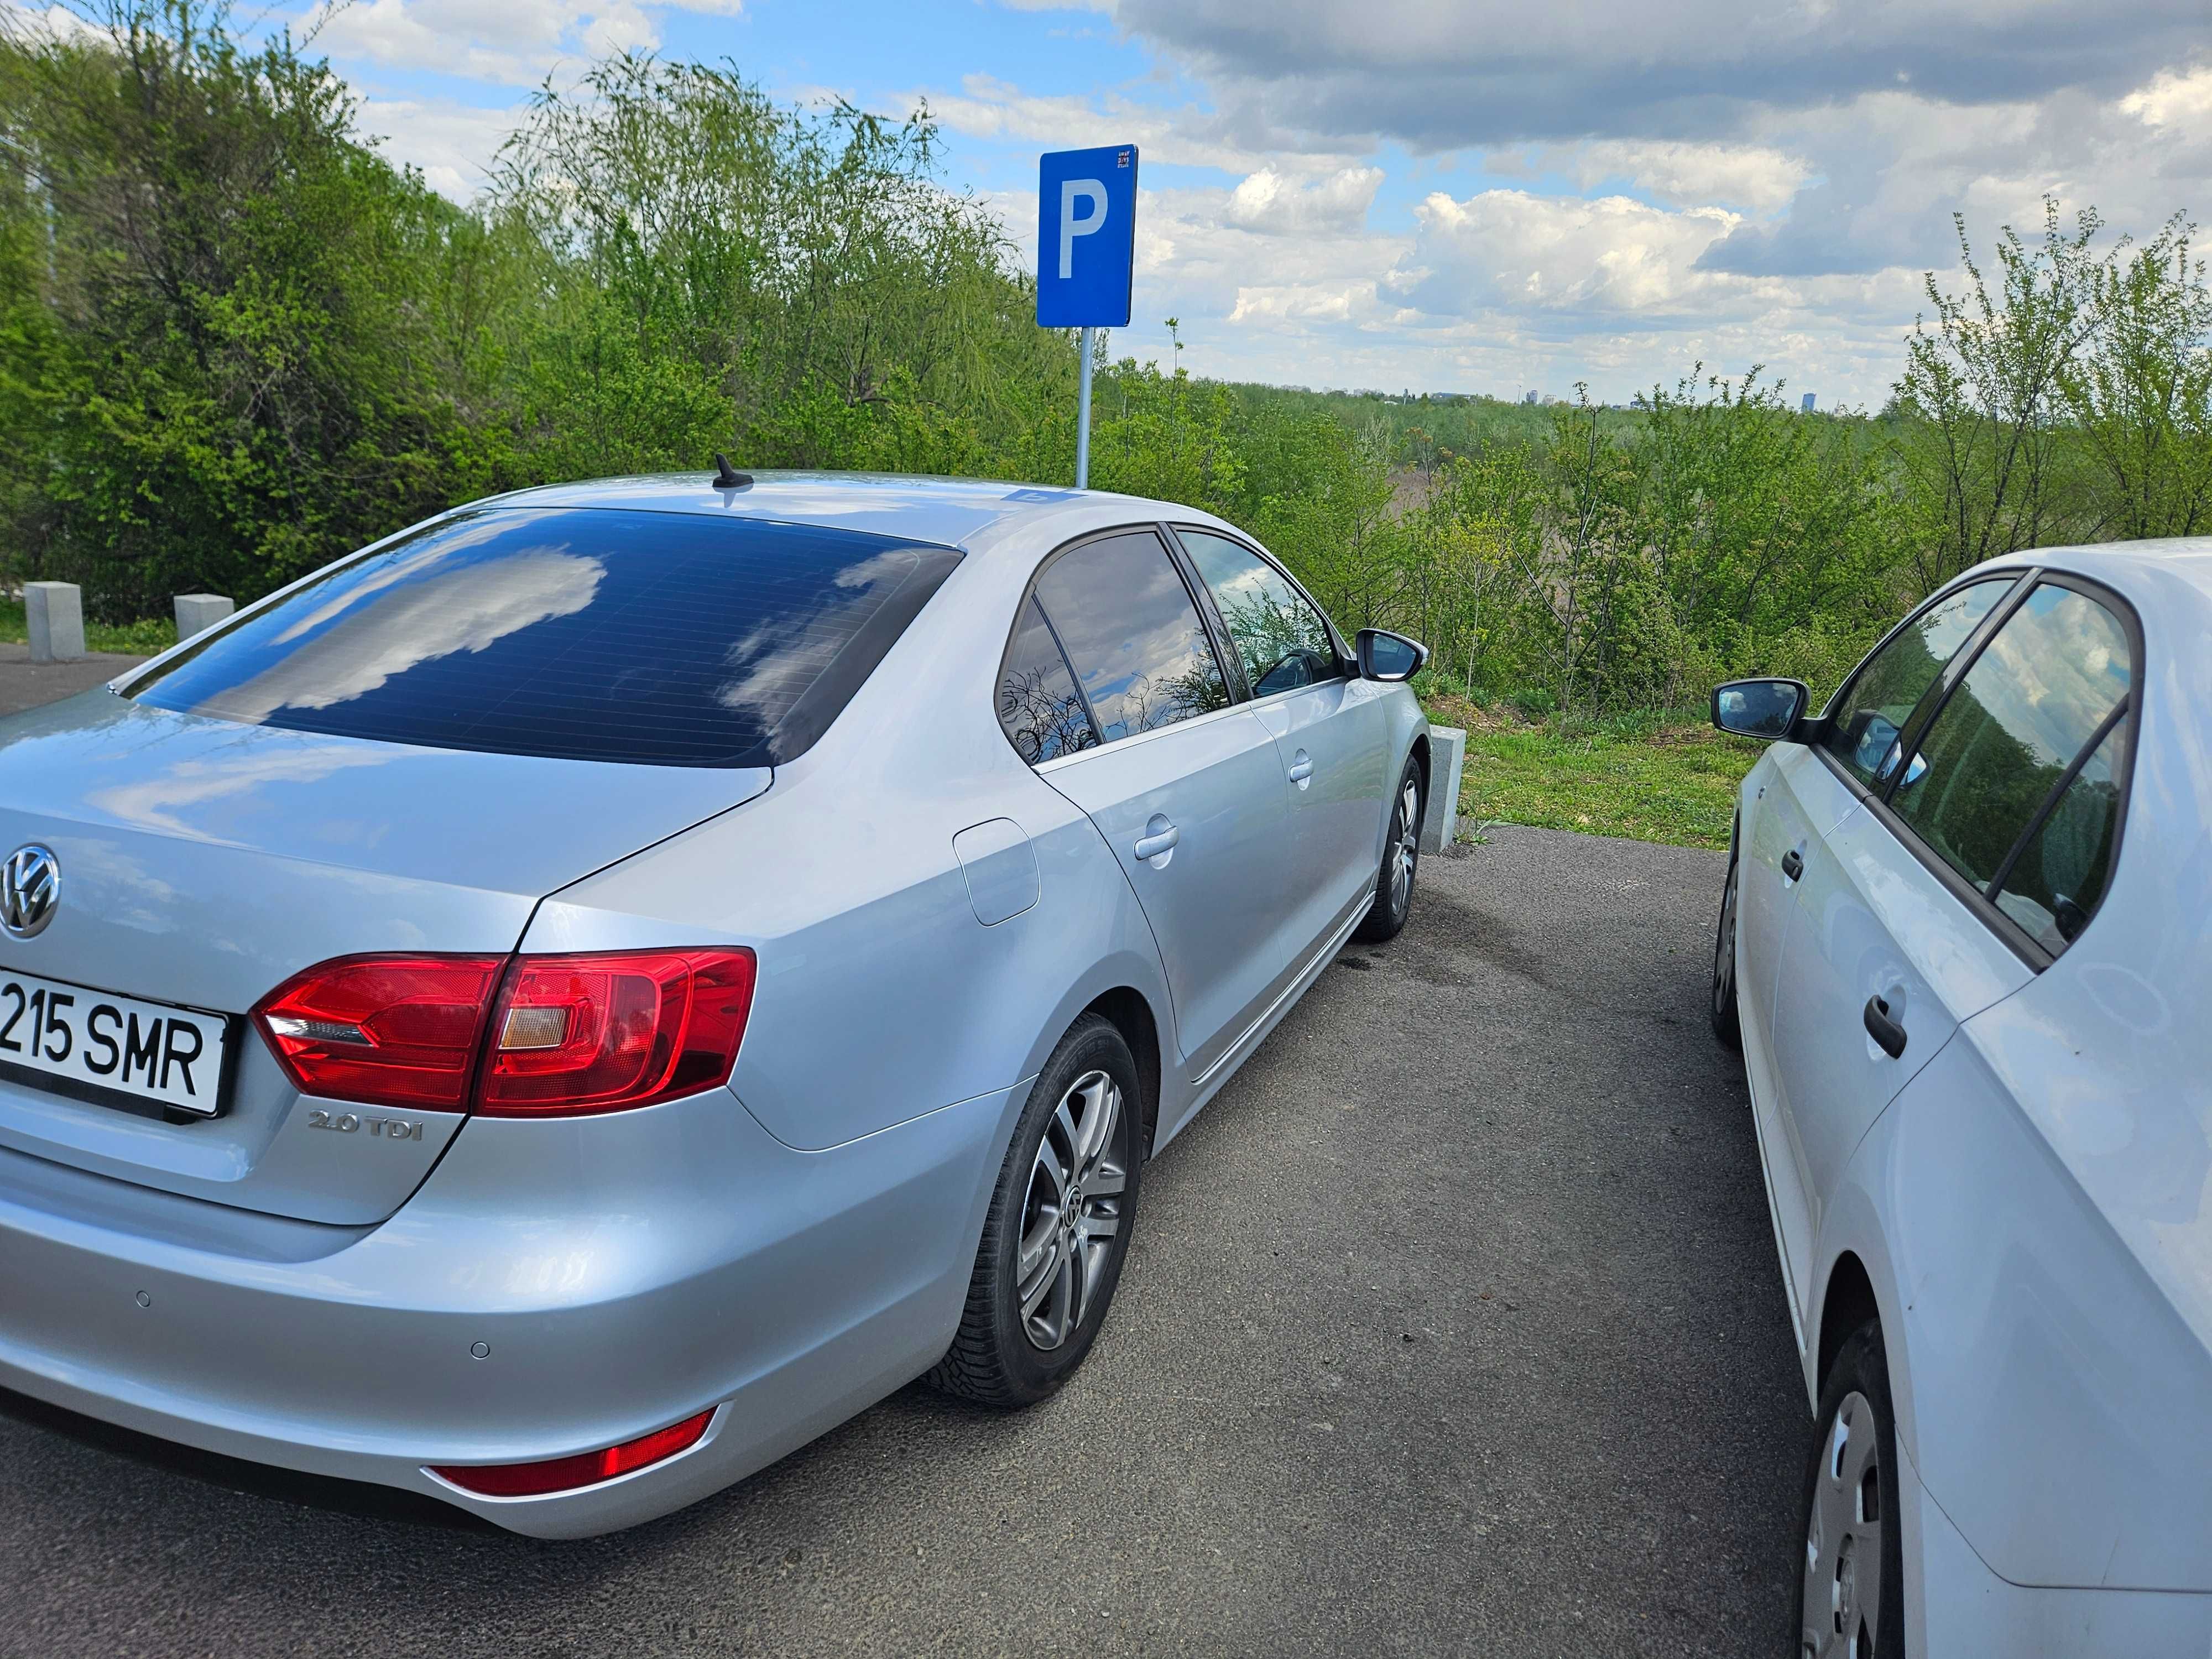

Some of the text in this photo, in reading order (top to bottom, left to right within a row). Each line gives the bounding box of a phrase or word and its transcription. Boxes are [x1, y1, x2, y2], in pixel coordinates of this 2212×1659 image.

[1059, 179, 1108, 279] P
[0, 983, 203, 1095] 215 SMR
[308, 1110, 422, 1141] 2.0 TDI
